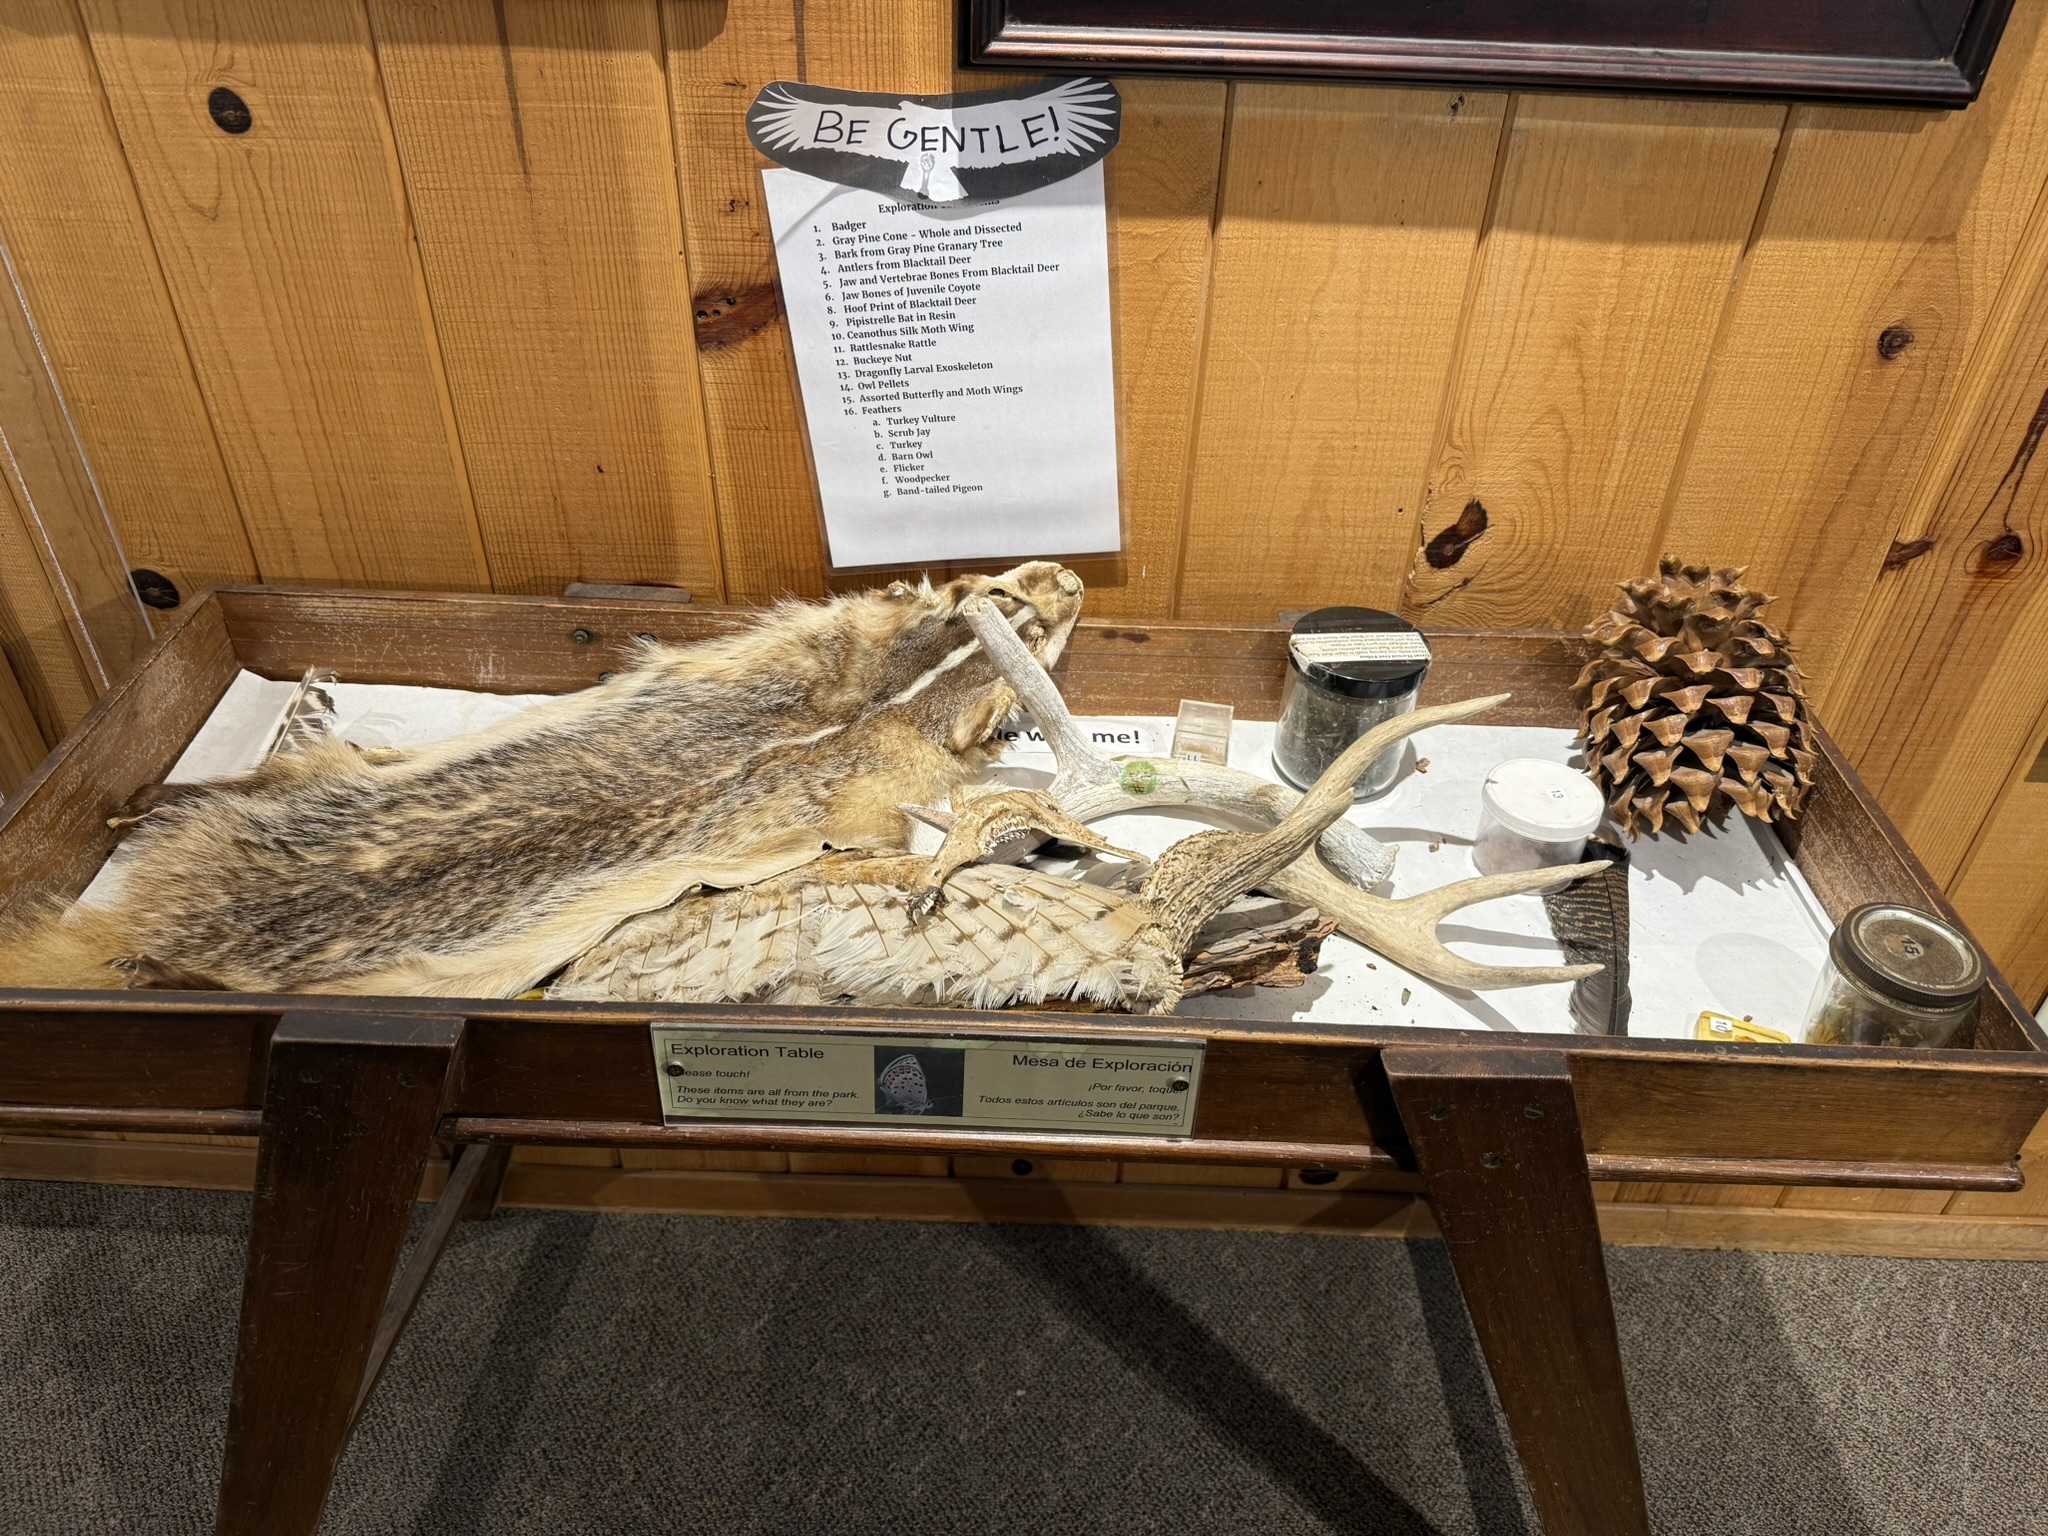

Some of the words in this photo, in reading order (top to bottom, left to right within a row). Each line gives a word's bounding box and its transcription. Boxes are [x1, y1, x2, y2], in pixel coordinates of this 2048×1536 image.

[813, 110, 870, 145] BE
[887, 106, 1060, 153] GENTLE!
[832, 221, 866, 232] Badger
[832, 236, 855, 246] Gray
[858, 233, 880, 243] Pine
[883, 233, 907, 241] Cone
[918, 228, 950, 238] Whole
[953, 226, 971, 236] and
[974, 222, 1022, 234] Dissected
[818, 253, 827, 262] 3.
[834, 248, 858, 259] Bark
[860, 248, 885, 257] from
[887, 246, 910, 256] Gray
[913, 243, 935, 253] Pine
[938, 242, 977, 251] Granary
[980, 239, 1003, 248] Tree
[821, 266, 830, 275] 4.
[838, 262, 873, 273] Antlers
[876, 260, 900, 270] from
[903, 256, 946, 268] Blacktail
[949, 256, 971, 265] Deer
[823, 280, 832, 289] 5.
[839, 278, 857, 288] Jaw
[860, 275, 877, 285] and
[879, 273, 927, 283] Vertebrae
[930, 272, 959, 280] Bones
[962, 269, 988, 278] From
[991, 264, 1034, 275] Blacktail
[1037, 264, 1059, 272] Deer
[825, 293, 834, 301] 6.
[842, 292, 859, 302] Jaw
[862, 290, 891, 299] Bones
[894, 287, 904, 296] of
[907, 284, 945, 297] Juvenile
[948, 283, 980, 294] Coyote
[827, 306, 836, 314] 8.
[844, 303, 867, 313] Hoof
[870, 302, 895, 311] Print
[897, 300, 907, 309] of
[909, 297, 952, 309] Blacktail
[954, 297, 976, 305] Deer
[829, 320, 838, 329] 9.
[846, 315, 895, 328] Pipistrelle
[898, 314, 914, 323] Bat
[916, 313, 926, 321] in
[929, 311, 956, 320] Resin
[847, 328, 897, 339] Ceanothus
[900, 326, 918, 335] Silk
[921, 324, 946, 334] Moth
[948, 323, 974, 333] Wing
[850, 340, 906, 352] Rattlesnake
[908, 338, 936, 348] Rattle
[853, 355, 892, 365] Buckeye
[895, 354, 912, 362] Nut
[838, 372, 850, 380] 13.
[855, 367, 902, 379] Dragonfly
[904, 364, 933, 374] Larval
[936, 362, 993, 372] Exoskeleton
[840, 384, 853, 392] 14.
[858, 381, 876, 390] Owl
[878, 380, 909, 389] Pellets
[842, 396, 855, 404] 15.
[860, 392, 900, 402] Assorted
[902, 389, 944, 399] Butterfly
[946, 388, 963, 397] and
[966, 386, 991, 396] Moth
[993, 385, 1023, 395] Wings
[844, 407, 857, 415] 16.
[862, 405, 902, 414] Feathers
[886, 416, 919, 426] Turkey
[921, 414, 956, 423] Vulture
[874, 430, 883, 438] b.
[888, 428, 914, 437] Scrub
[917, 428, 930, 437] Jay
[889, 440, 922, 449] Turkey
[878, 453, 886, 461] d.
[916, 451, 933, 459] Owl
[893, 463, 924, 472] Flicker
[882, 476, 888, 484] f.
[895, 474, 950, 484] Woodpecker
[883, 490, 891, 498] g.
[897, 485, 950, 495] Band-tailed
[953, 484, 983, 494] Pigeon
[1092, 730, 1140, 743] me!
[1550, 790, 1564, 798] 13
[1900, 938, 1920, 954] 15
[1715, 1020, 1728, 1032] 10
[671, 1044, 769, 1057] Exploration
[775, 1046, 824, 1059] Table
[1013, 1055, 1059, 1067] Mesa
[1065, 1057, 1086, 1068] de
[1092, 1058, 1192, 1073] Exploración
[677, 1086, 710, 1094] These
[832, 1091, 859, 1099] park.
[1088, 1083, 1113, 1091] ¡Por
[1115, 1084, 1144, 1093] favor,
[782, 1099, 805, 1107] they
[1047, 1099, 1093, 1107] artículos
[1138, 1104, 1179, 1112] parque.
[1078, 1109, 1113, 1118] ¿Sabe
[1116, 1110, 1126, 1119] lo
